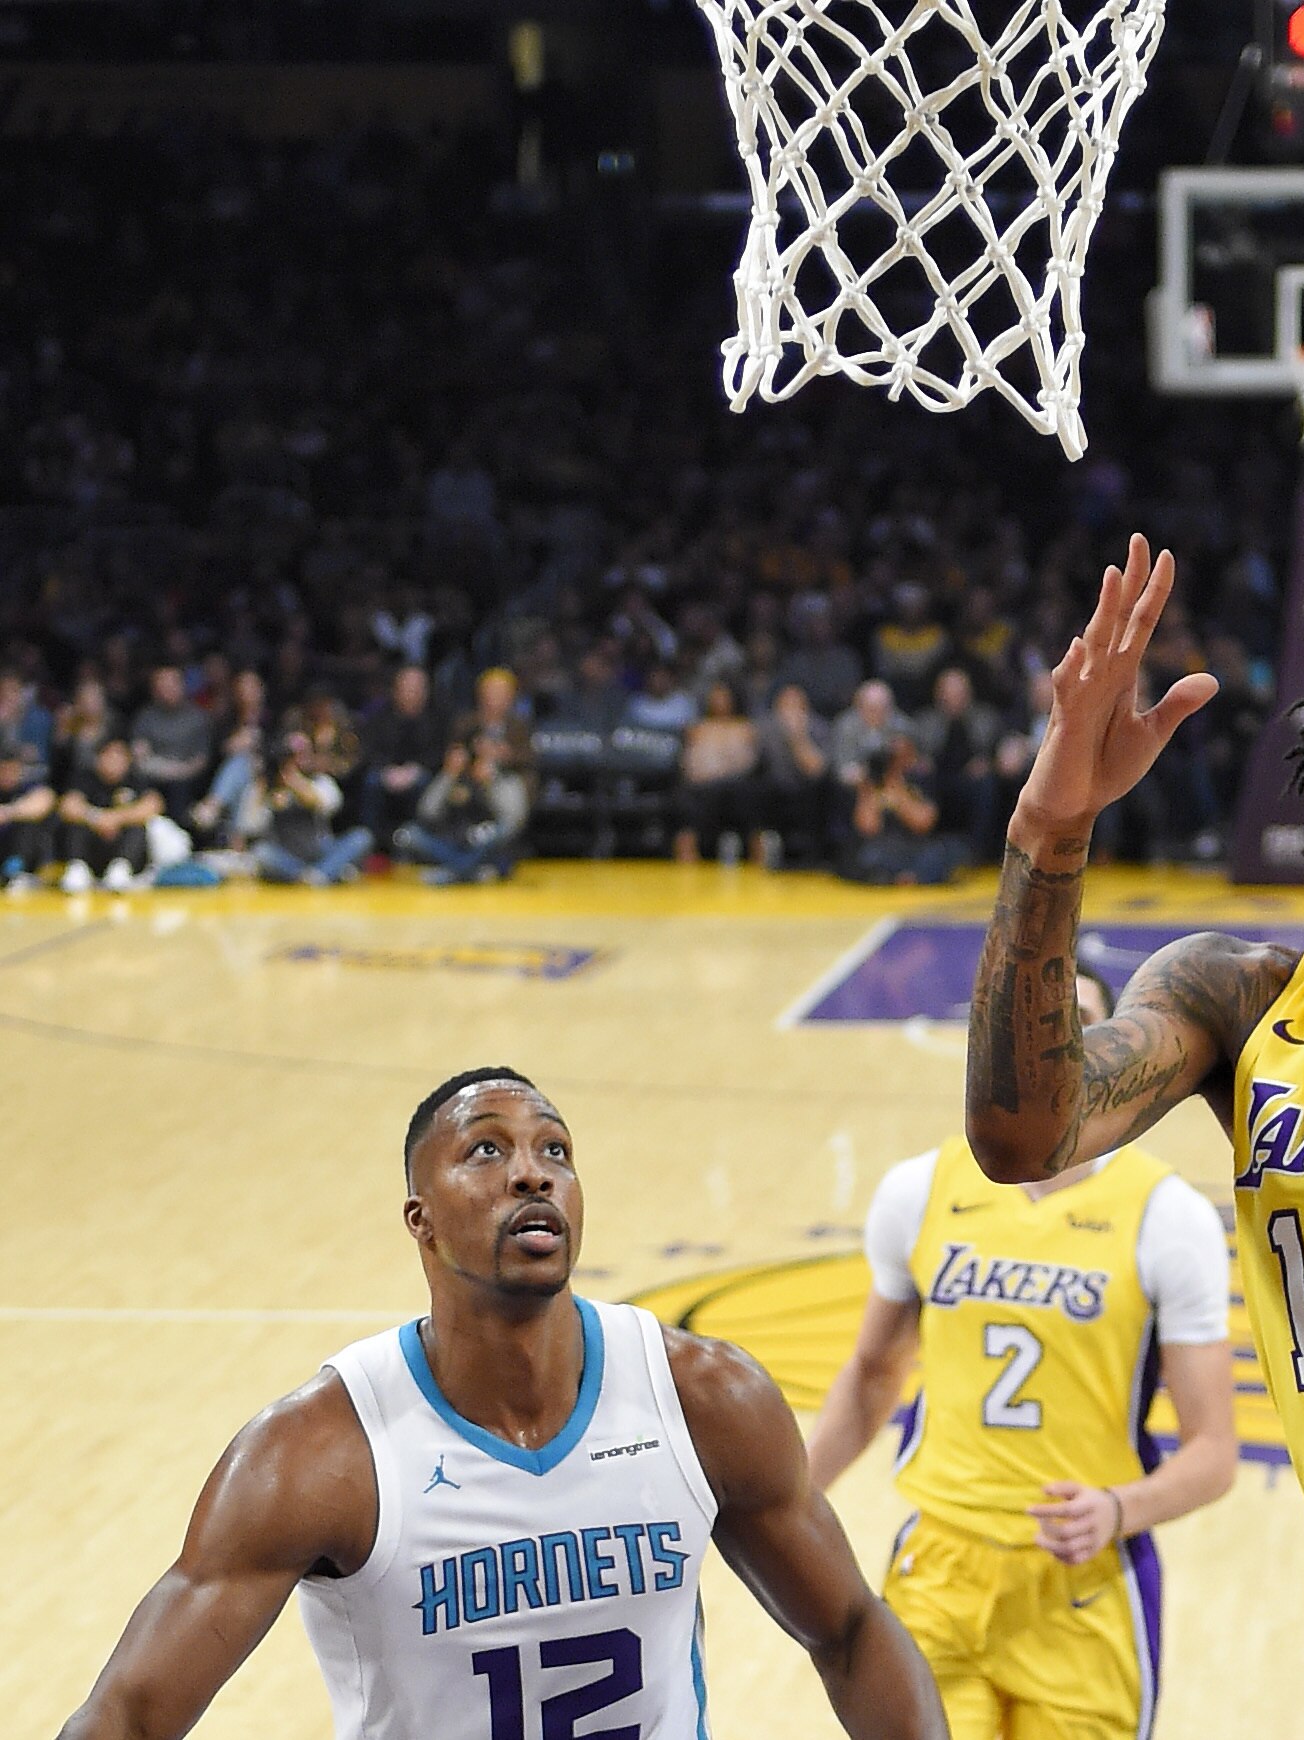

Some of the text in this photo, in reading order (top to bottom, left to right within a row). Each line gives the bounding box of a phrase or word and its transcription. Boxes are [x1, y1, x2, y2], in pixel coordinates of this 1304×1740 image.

[929, 1242, 1110, 1324] LAKERS
[983, 1322, 1043, 1430] 2
[411, 1521, 691, 1636] HORNETS
[472, 1627, 644, 1740] 12
